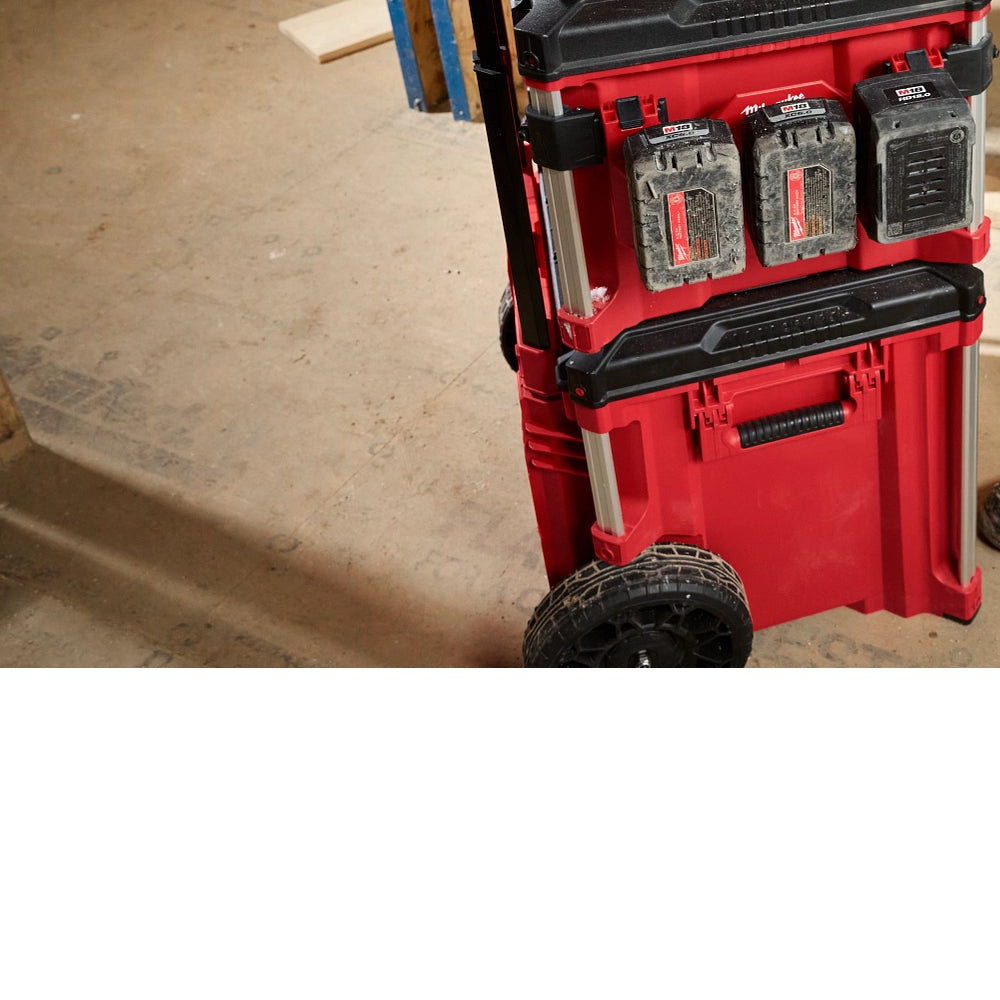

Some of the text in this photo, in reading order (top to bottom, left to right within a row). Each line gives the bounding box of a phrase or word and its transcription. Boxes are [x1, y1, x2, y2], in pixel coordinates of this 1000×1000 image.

[898, 86, 923, 95] M18
[782, 103, 808, 112] M18
[664, 123, 691, 133] M18
